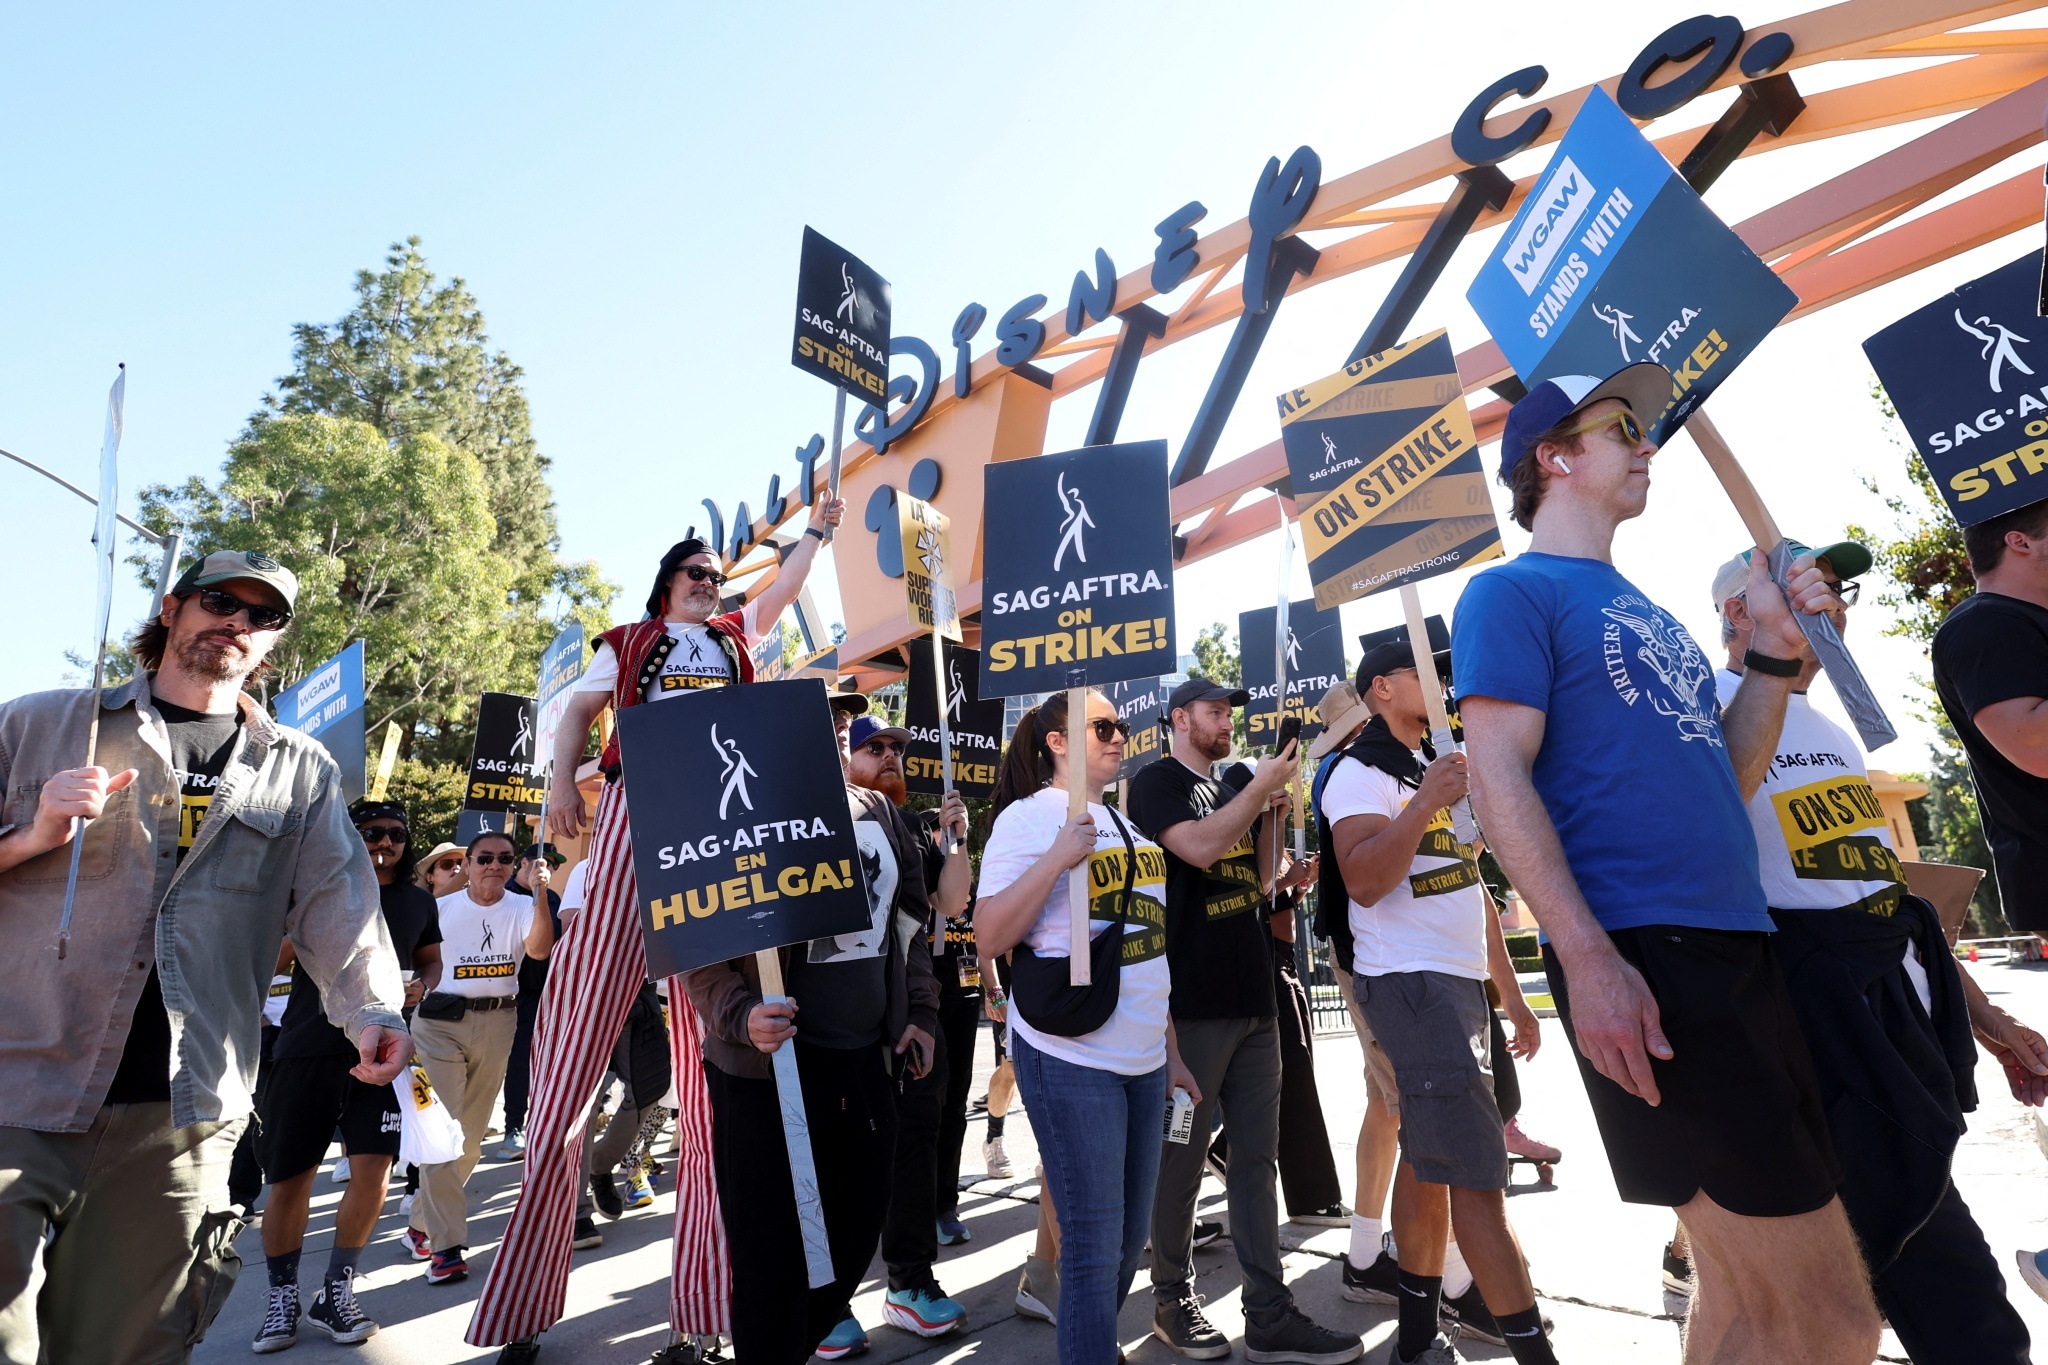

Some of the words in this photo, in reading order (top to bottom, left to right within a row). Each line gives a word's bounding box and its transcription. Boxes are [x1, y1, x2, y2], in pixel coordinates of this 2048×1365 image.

[1514, 172, 1579, 275] WGAW
[1529, 252, 1589, 339] STANDS
[1580, 186, 1634, 257] WITH
[836, 343, 853, 359] ON
[797, 336, 885, 396] STRIKE!
[2023, 415, 2048, 437] O
[1313, 493, 1359, 538] ON
[1354, 418, 1463, 508] STRIKE
[1351, 551, 1460, 591] #SAGAFTRASTRONG
[907, 571, 955, 604] SUPPORTS
[918, 607, 953, 634] RIGHTS
[1058, 608, 1092, 627] ON
[989, 617, 1168, 672] STRIKE!
[1604, 622, 1640, 706] WRITERS
[300, 672, 338, 707] WGAW
[1249, 674, 1340, 700] SAGAFTRA
[324, 694, 347, 722] WITH
[1285, 697, 1304, 708] ON
[910, 726, 996, 750] SAGAFTRA
[1120, 725, 1157, 761] IKE!
[508, 776, 524, 786] ON
[1789, 793, 1838, 836] ON
[1434, 833, 1450, 850] ON
[735, 852, 767, 872] EN
[1091, 853, 1122, 888] ON
[1221, 862, 1234, 878] ON
[1838, 844, 1866, 871] ON
[650, 859, 854, 931] HUELGA!
[1413, 881, 1430, 892] ON
[1429, 871, 1464, 890] STRIKE
[1206, 902, 1220, 915] ON
[1220, 895, 1246, 913] STRIKE
[456, 963, 514, 978] STRONG
[271, 987, 279, 995] ON
[1172, 1130, 1181, 1138] IS
